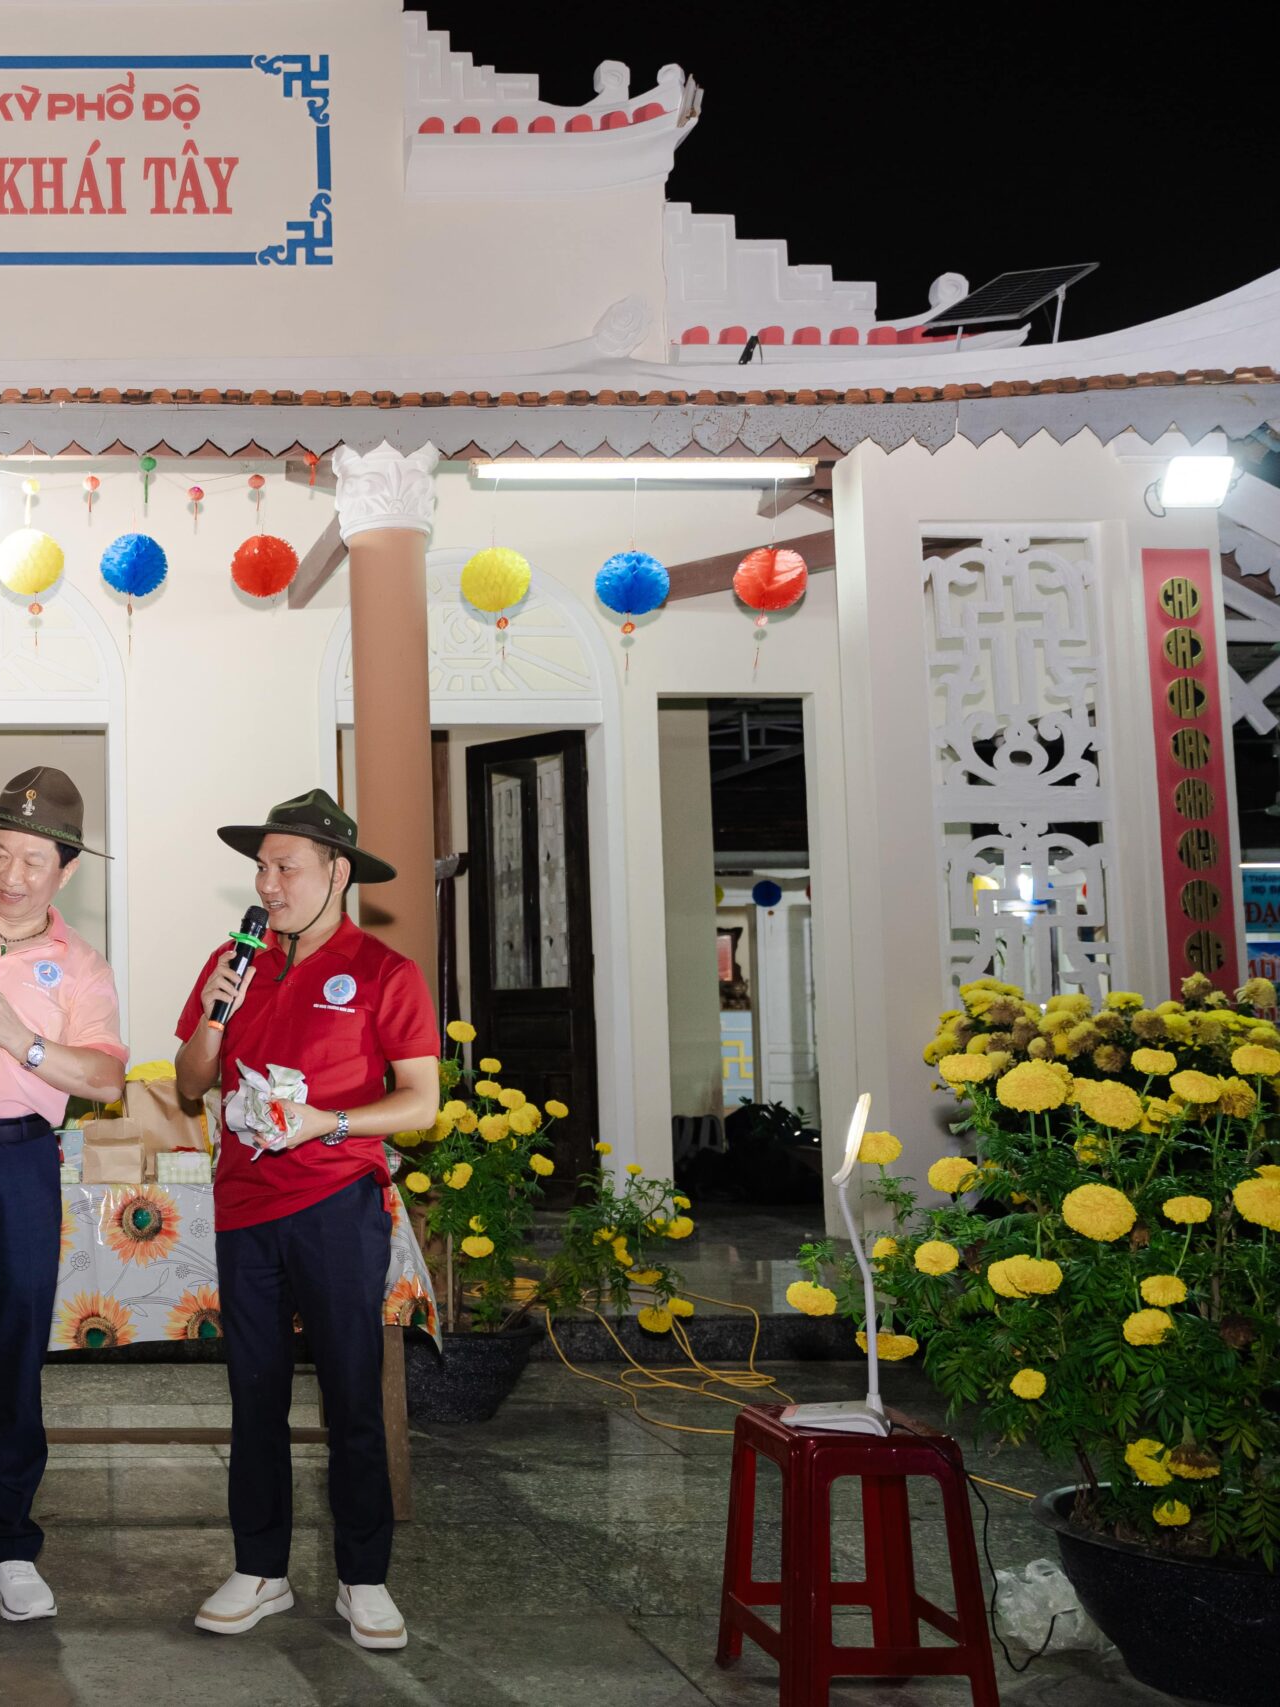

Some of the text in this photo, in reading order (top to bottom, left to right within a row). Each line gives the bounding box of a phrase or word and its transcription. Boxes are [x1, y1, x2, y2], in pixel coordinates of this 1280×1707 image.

[46, 70, 136, 122] PHỔ
[142, 83, 201, 131] ĐỘ
[142, 138, 240, 216] TÂY
